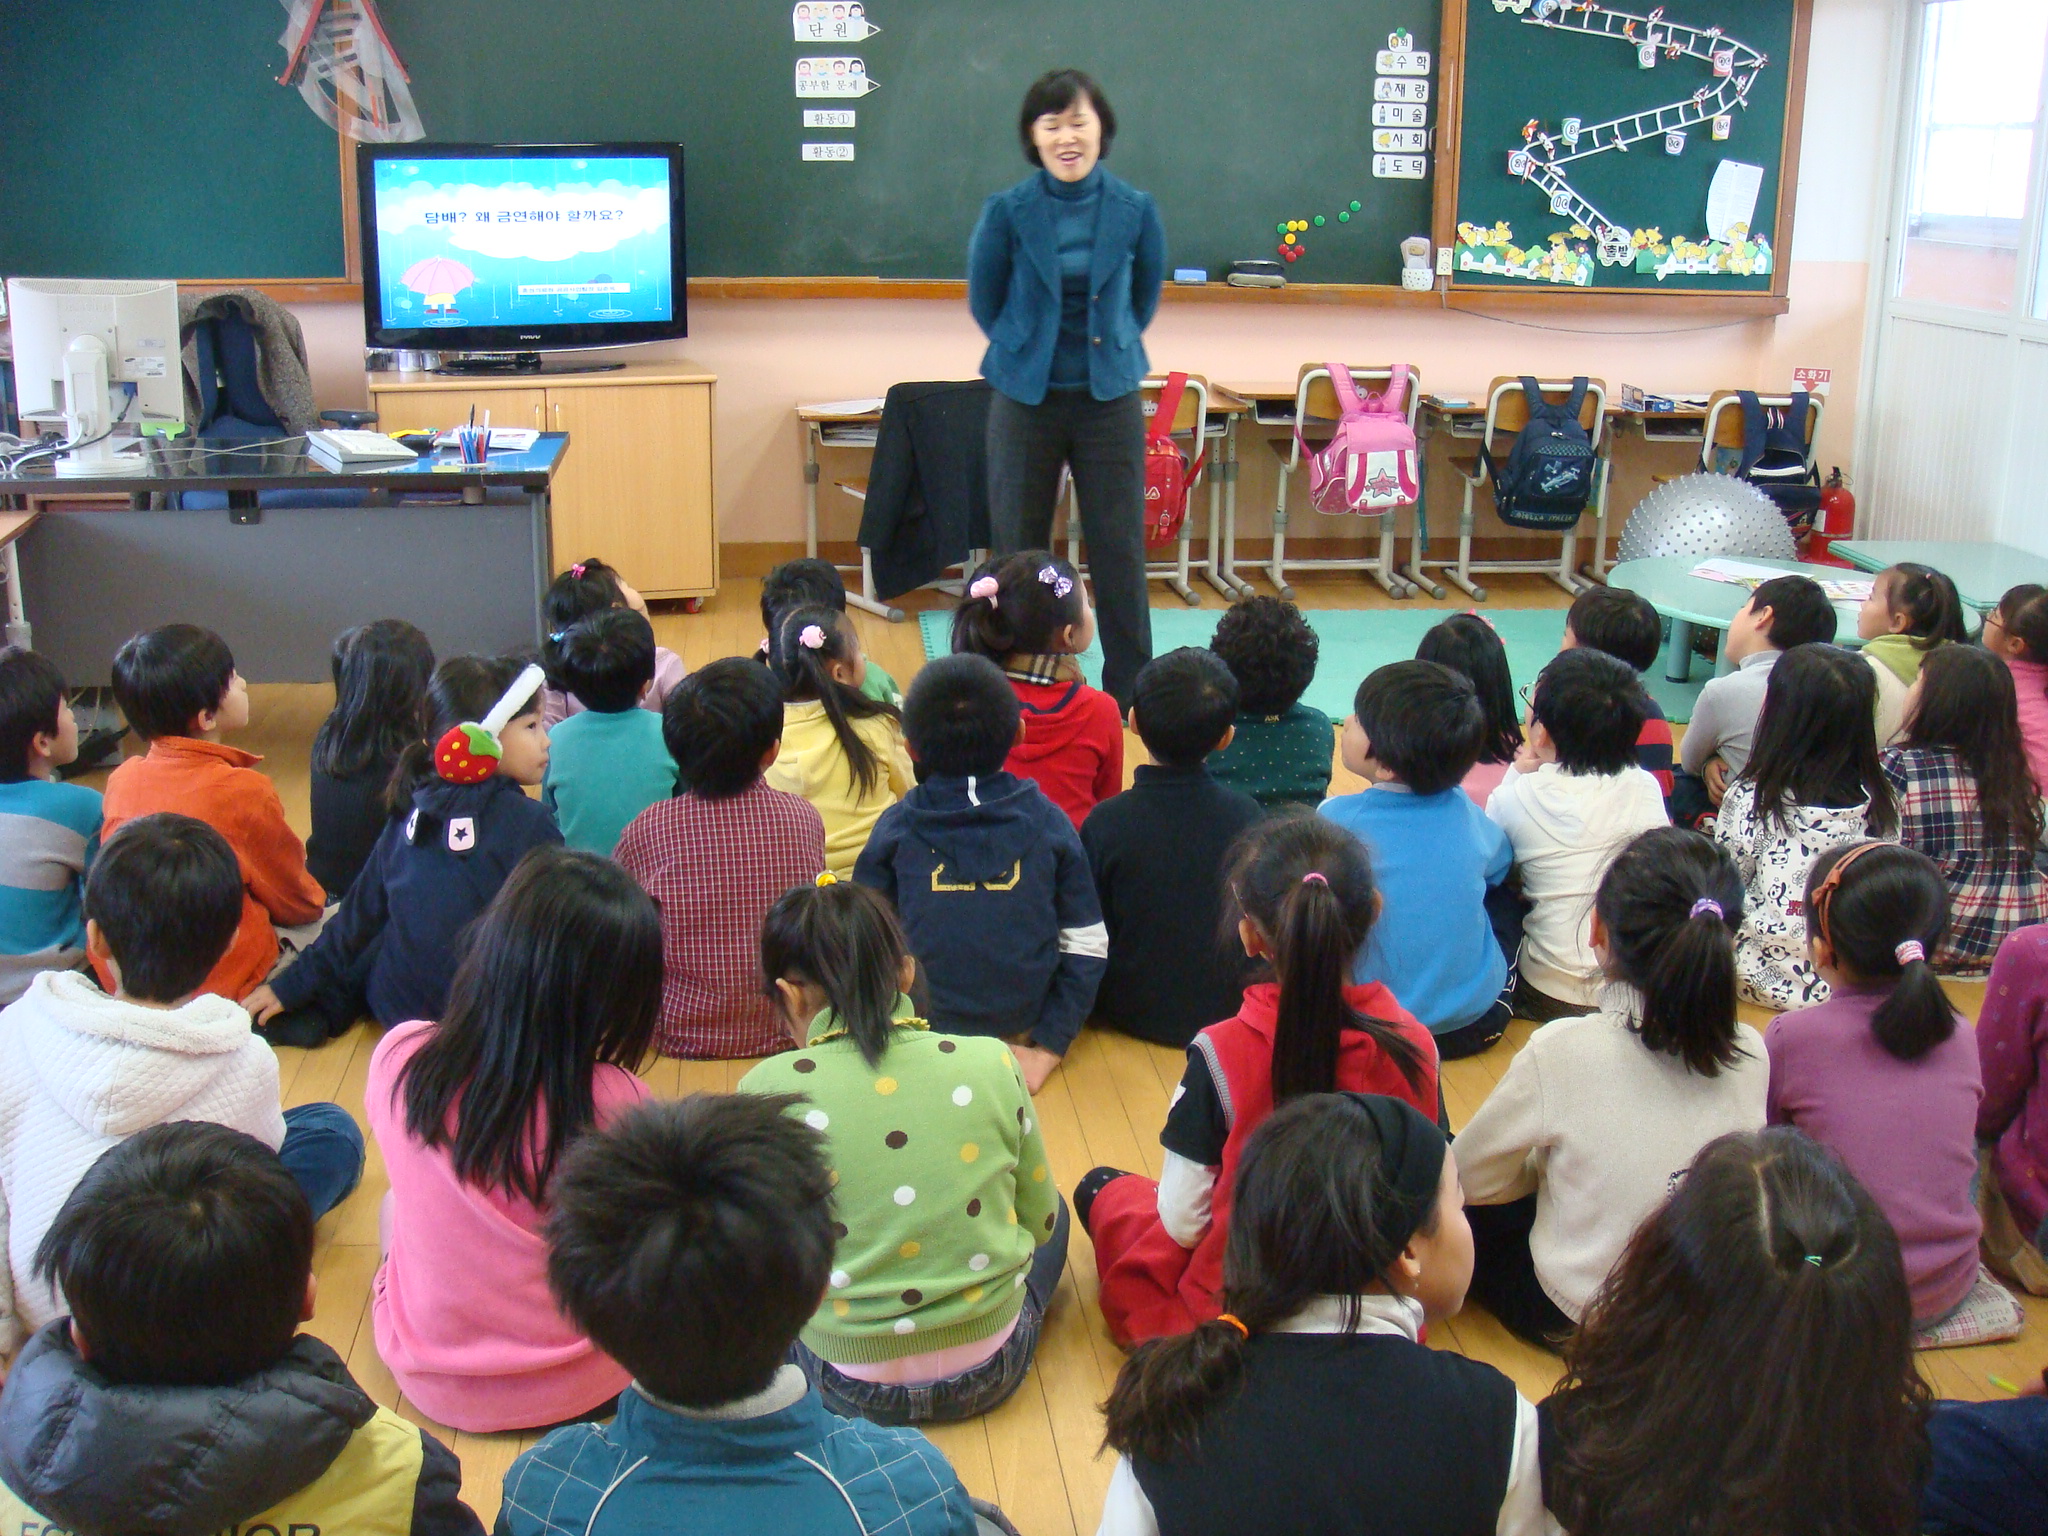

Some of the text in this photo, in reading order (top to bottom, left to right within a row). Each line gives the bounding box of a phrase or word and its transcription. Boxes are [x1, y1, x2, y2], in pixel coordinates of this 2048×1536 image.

[799, 80, 858, 91] 공부할 문제
[425, 209, 624, 224] 담배? 왜 금연해야 할까요?
[1606, 243, 1628, 258] 출발
[1796, 369, 1828, 382] 소화기
